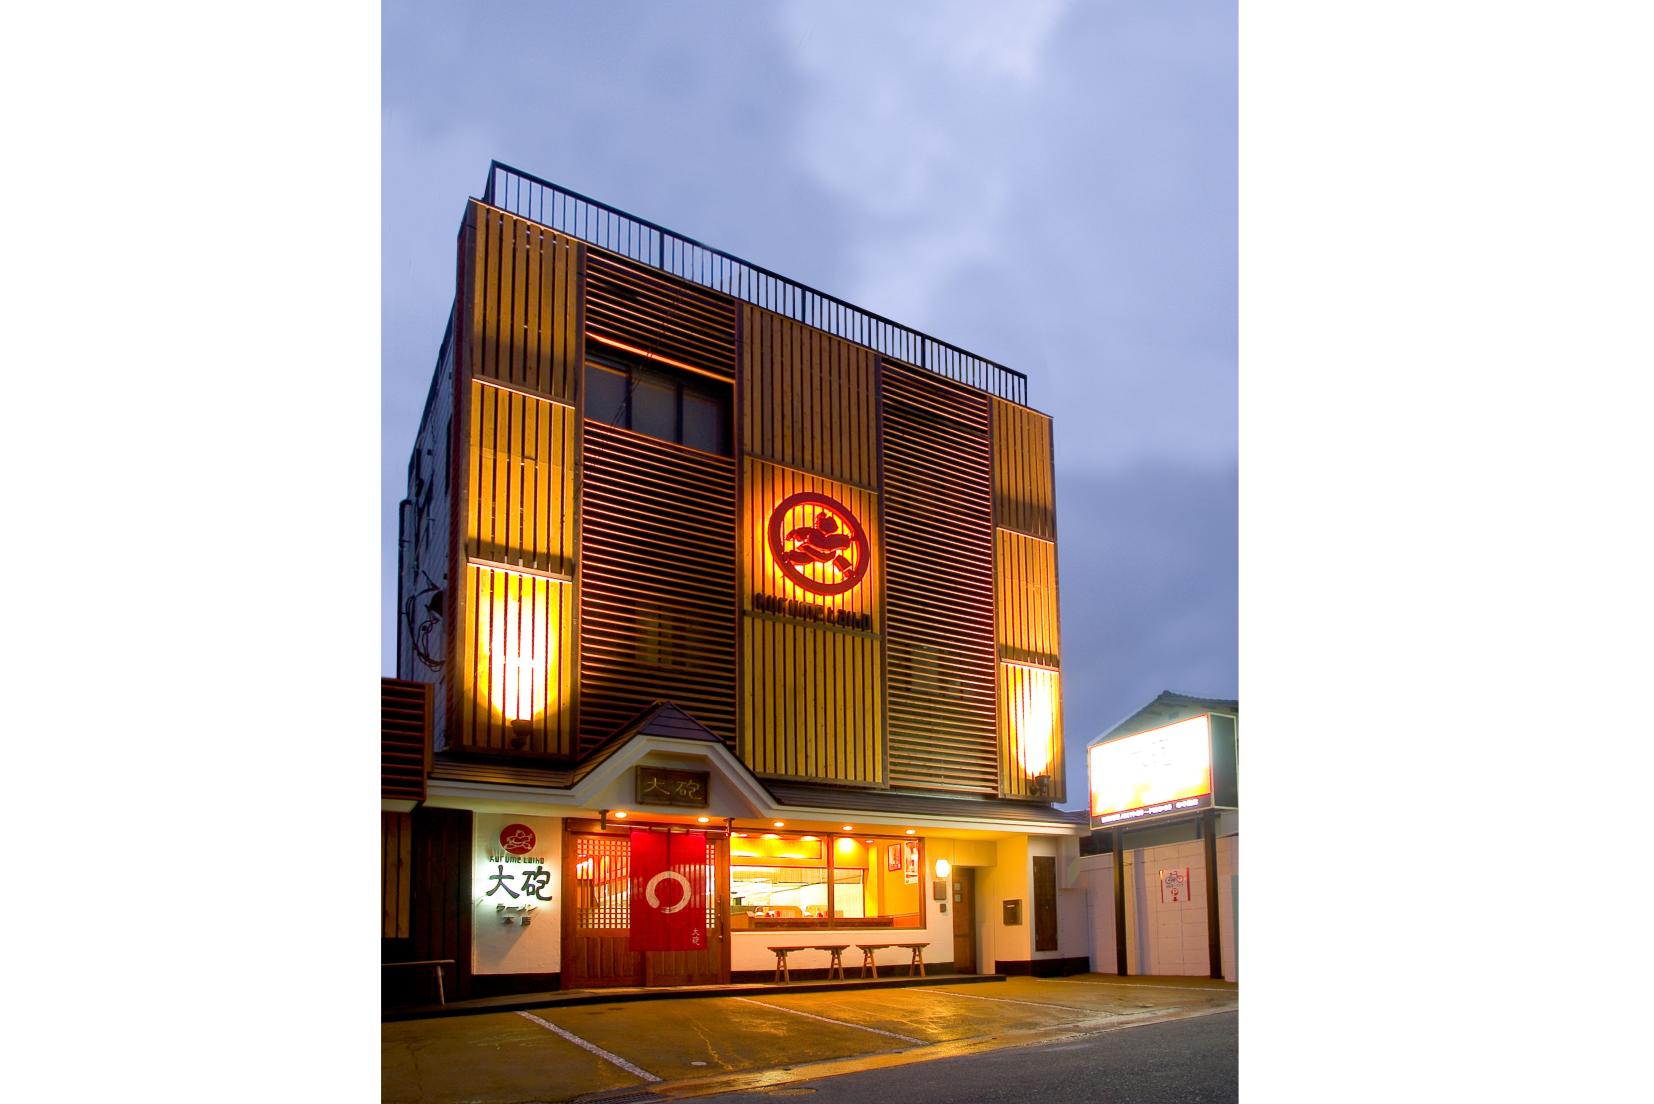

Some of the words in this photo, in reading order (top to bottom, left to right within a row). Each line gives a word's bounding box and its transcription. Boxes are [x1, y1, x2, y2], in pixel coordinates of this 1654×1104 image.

[644, 777, 702, 800] 大砲
[486, 864, 552, 901] 大砲
[496, 903, 537, 913] ラーメン
[691, 927, 700, 946] 大砲
